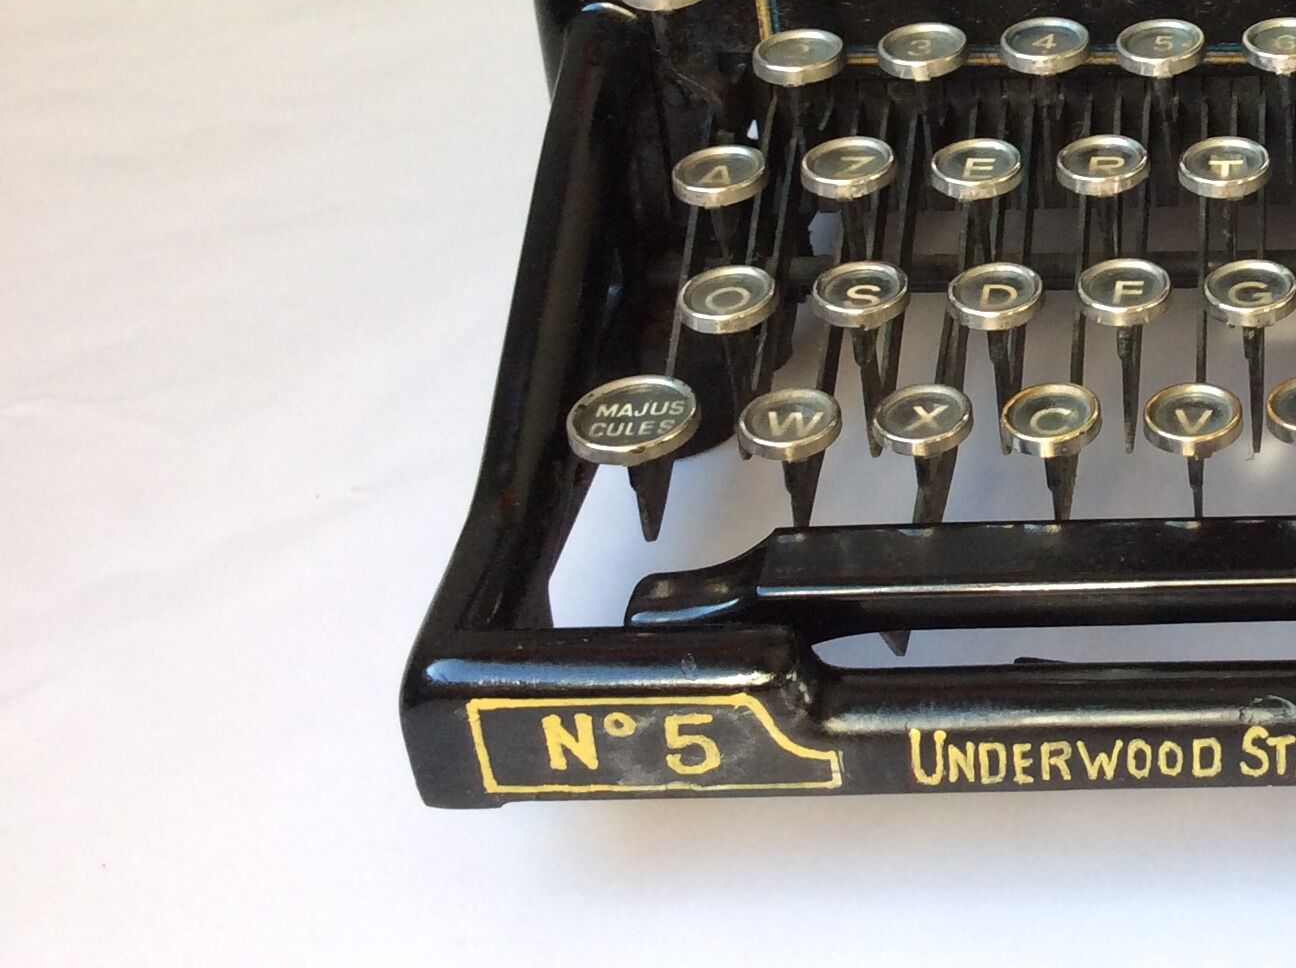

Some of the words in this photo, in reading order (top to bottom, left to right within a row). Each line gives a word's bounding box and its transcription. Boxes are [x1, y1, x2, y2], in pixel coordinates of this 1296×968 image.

[1031, 33, 1057, 50] 4
[1153, 35, 1174, 51] 5
[699, 164, 731, 186] A
[839, 155, 877, 179] Z
[960, 157, 997, 180] E
[1088, 155, 1126, 176] R
[1208, 158, 1244, 179] T
[843, 284, 883, 308] S
[979, 283, 1018, 308] D
[1112, 280, 1146, 305] F
[1227, 280, 1273, 307] G
[596, 398, 685, 420] MAJUS
[904, 404, 949, 431] X
[1029, 407, 1075, 435] C
[588, 418, 676, 438] CULES
[767, 410, 824, 435] W
[1174, 408, 1213, 435] V
[664, 712, 721, 775] 5
[909, 728, 1223, 785] UNDERWOOD
